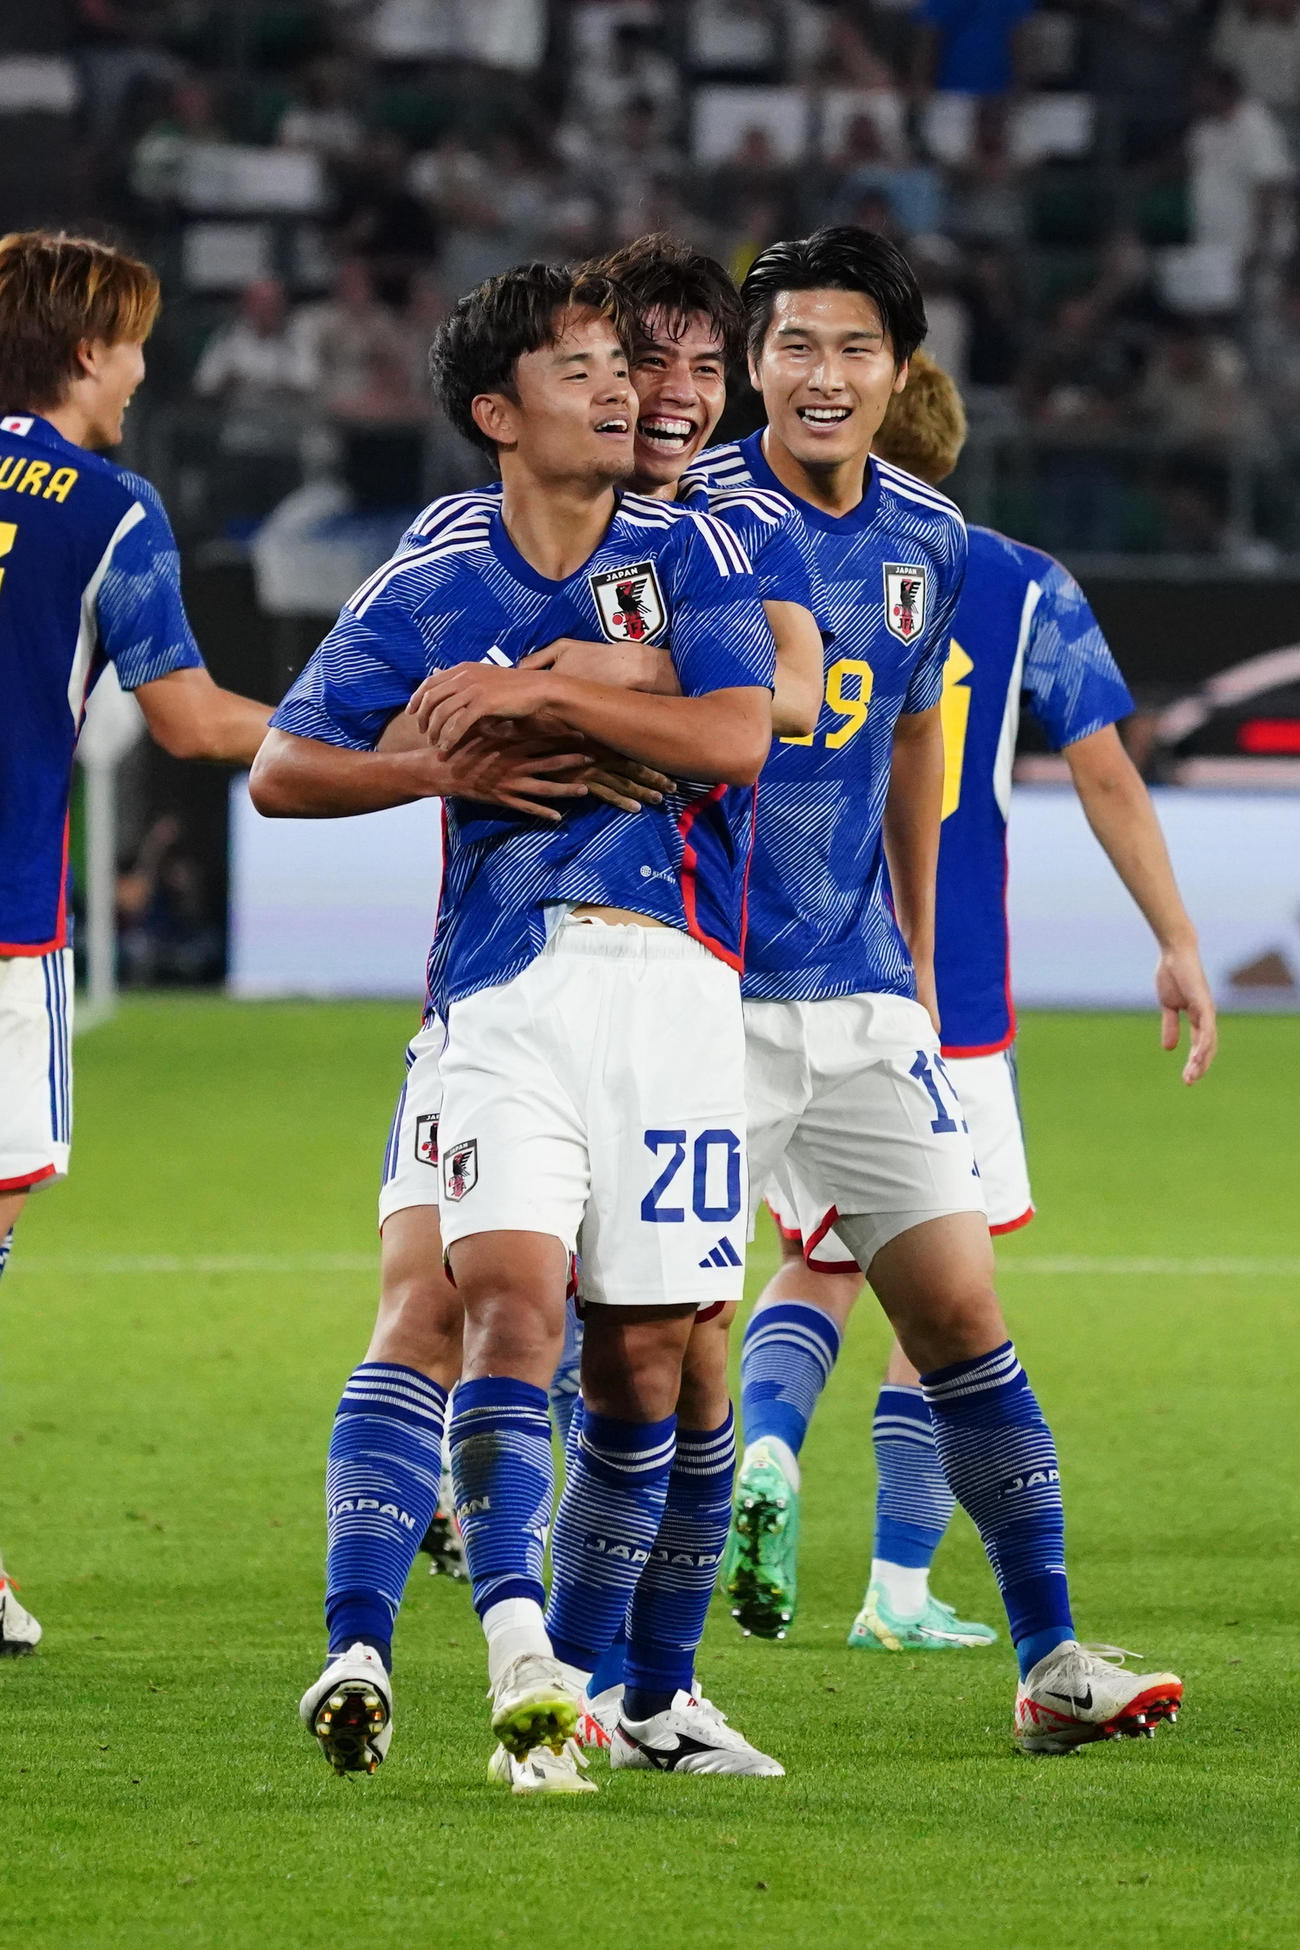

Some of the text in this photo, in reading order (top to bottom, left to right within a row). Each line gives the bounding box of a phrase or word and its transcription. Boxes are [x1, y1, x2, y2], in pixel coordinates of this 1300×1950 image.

[0, 456, 79, 503] URA
[606, 567, 638, 582] JAPAN
[895, 566, 917, 575] JAPAN
[622, 619, 650, 637] JFA
[779, 658, 874, 749] 9
[641, 1129, 741, 1223] 20
[329, 1498, 416, 1530] JAPAN
[457, 1496, 491, 1519] AN
[586, 1539, 651, 1566] JAP
[650, 1549, 726, 1567] JAP
